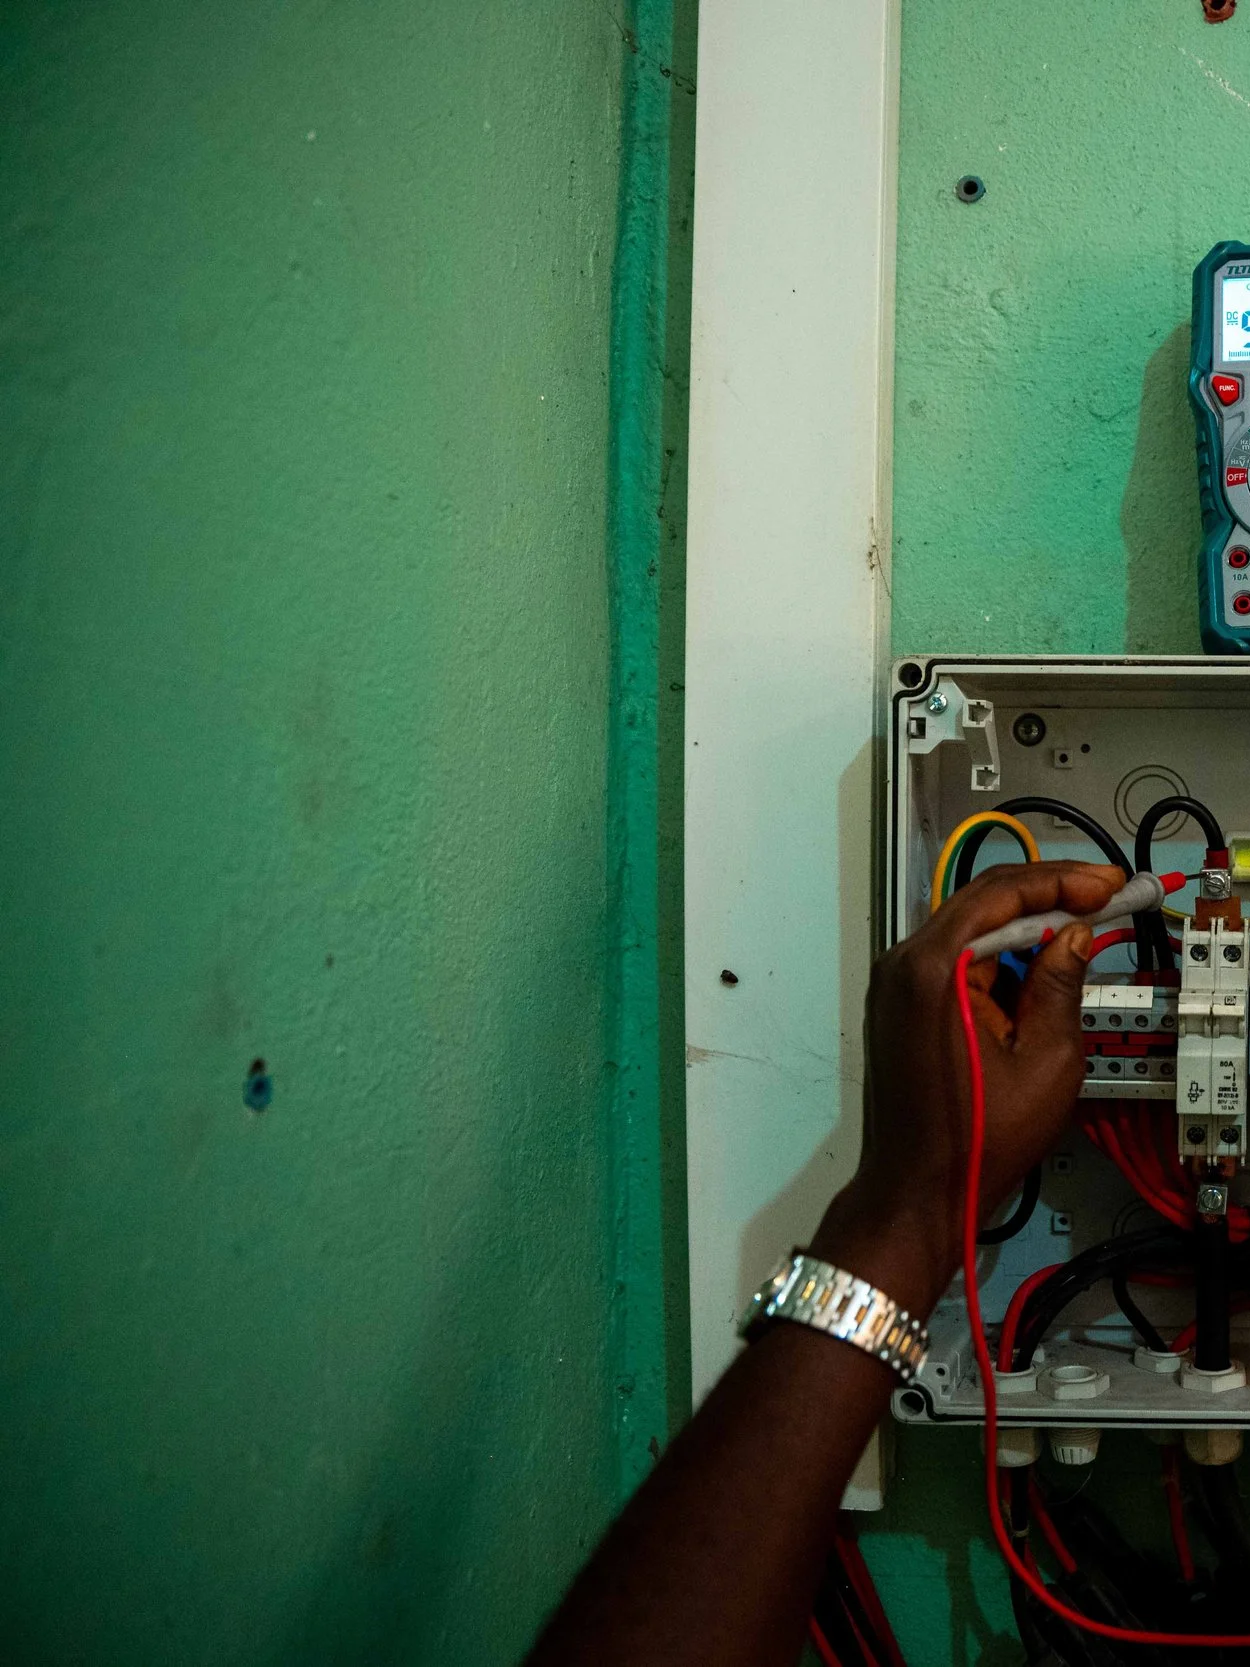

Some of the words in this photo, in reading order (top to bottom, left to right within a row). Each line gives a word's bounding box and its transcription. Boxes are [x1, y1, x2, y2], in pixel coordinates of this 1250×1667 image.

[1226, 311, 1239, 321] DC
[1219, 384, 1236, 392] FUNC.
[1227, 473, 1245, 482] OFF
